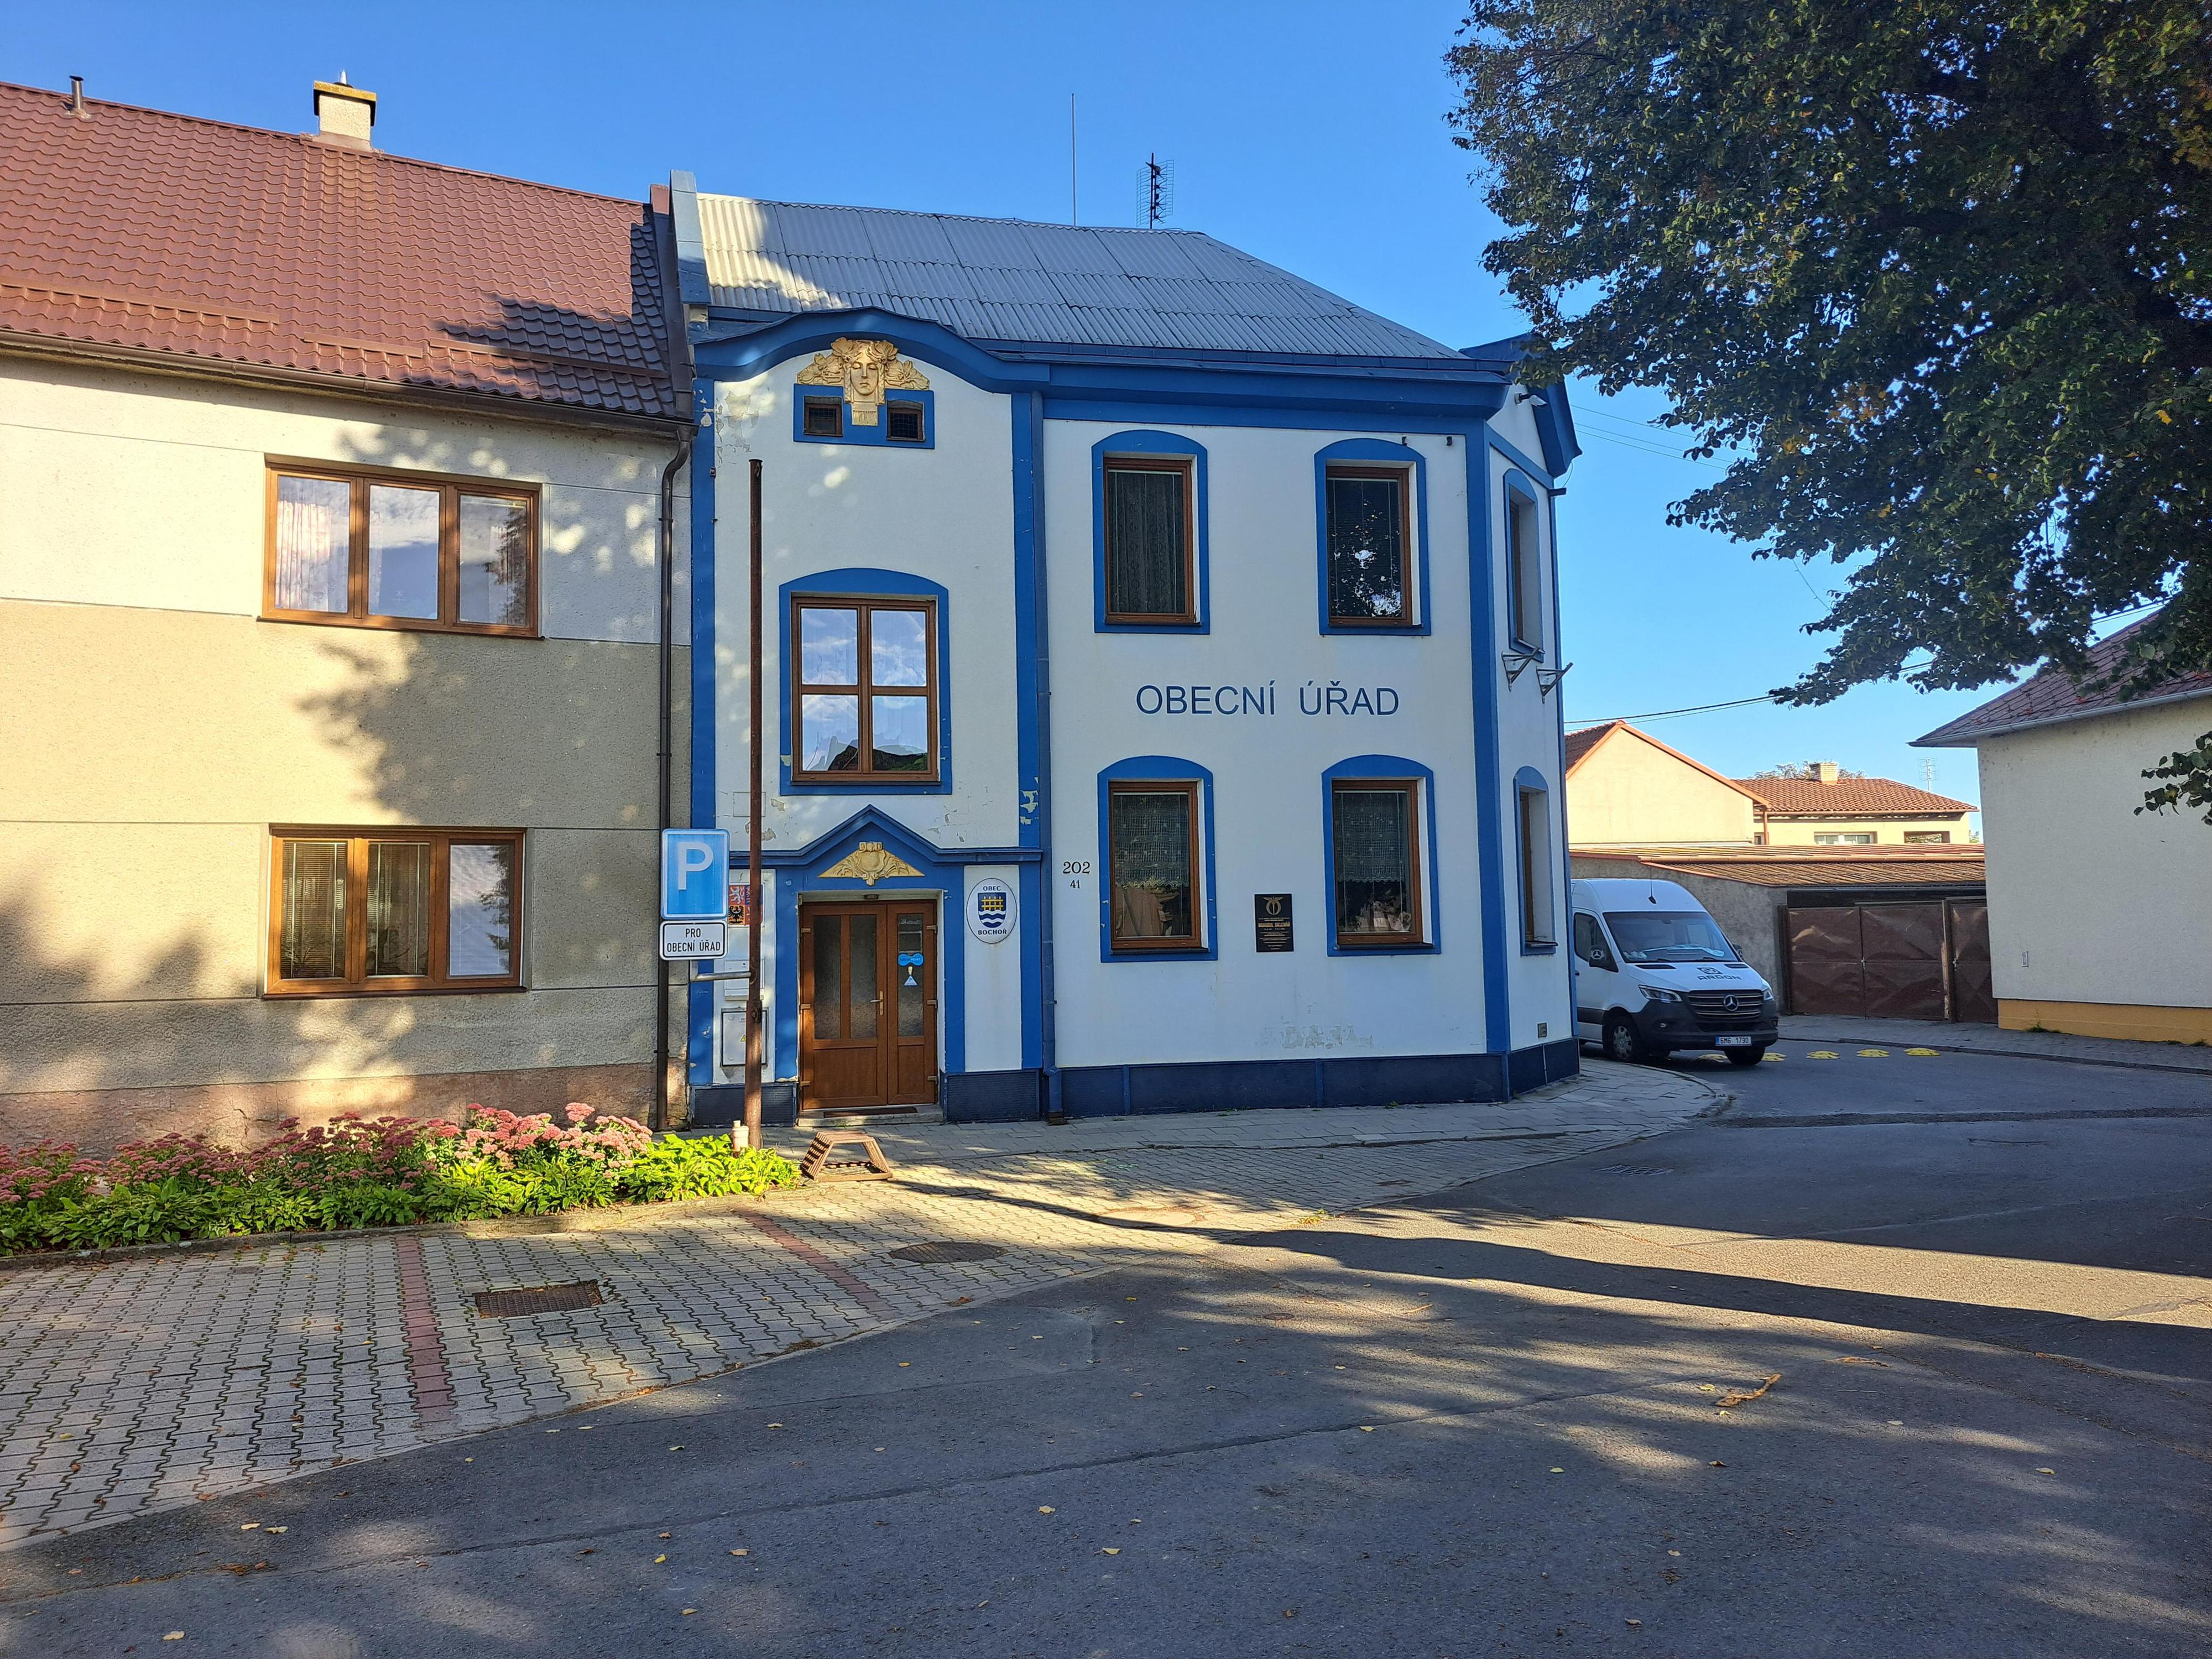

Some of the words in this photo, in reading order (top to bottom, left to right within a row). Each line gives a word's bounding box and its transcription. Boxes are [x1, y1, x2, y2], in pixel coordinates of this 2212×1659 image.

[1136, 680, 1276, 716] OBECNÍ
[1299, 680, 1400, 716] ÚŘAD
[678, 842, 714, 890] P
[1062, 861, 1091, 874] 202
[1070, 879, 1080, 889] 41
[685, 928, 701, 938] PRO
[666, 940, 695, 952] OBECNÍ
[699, 940, 721, 952] ÚŘAD
